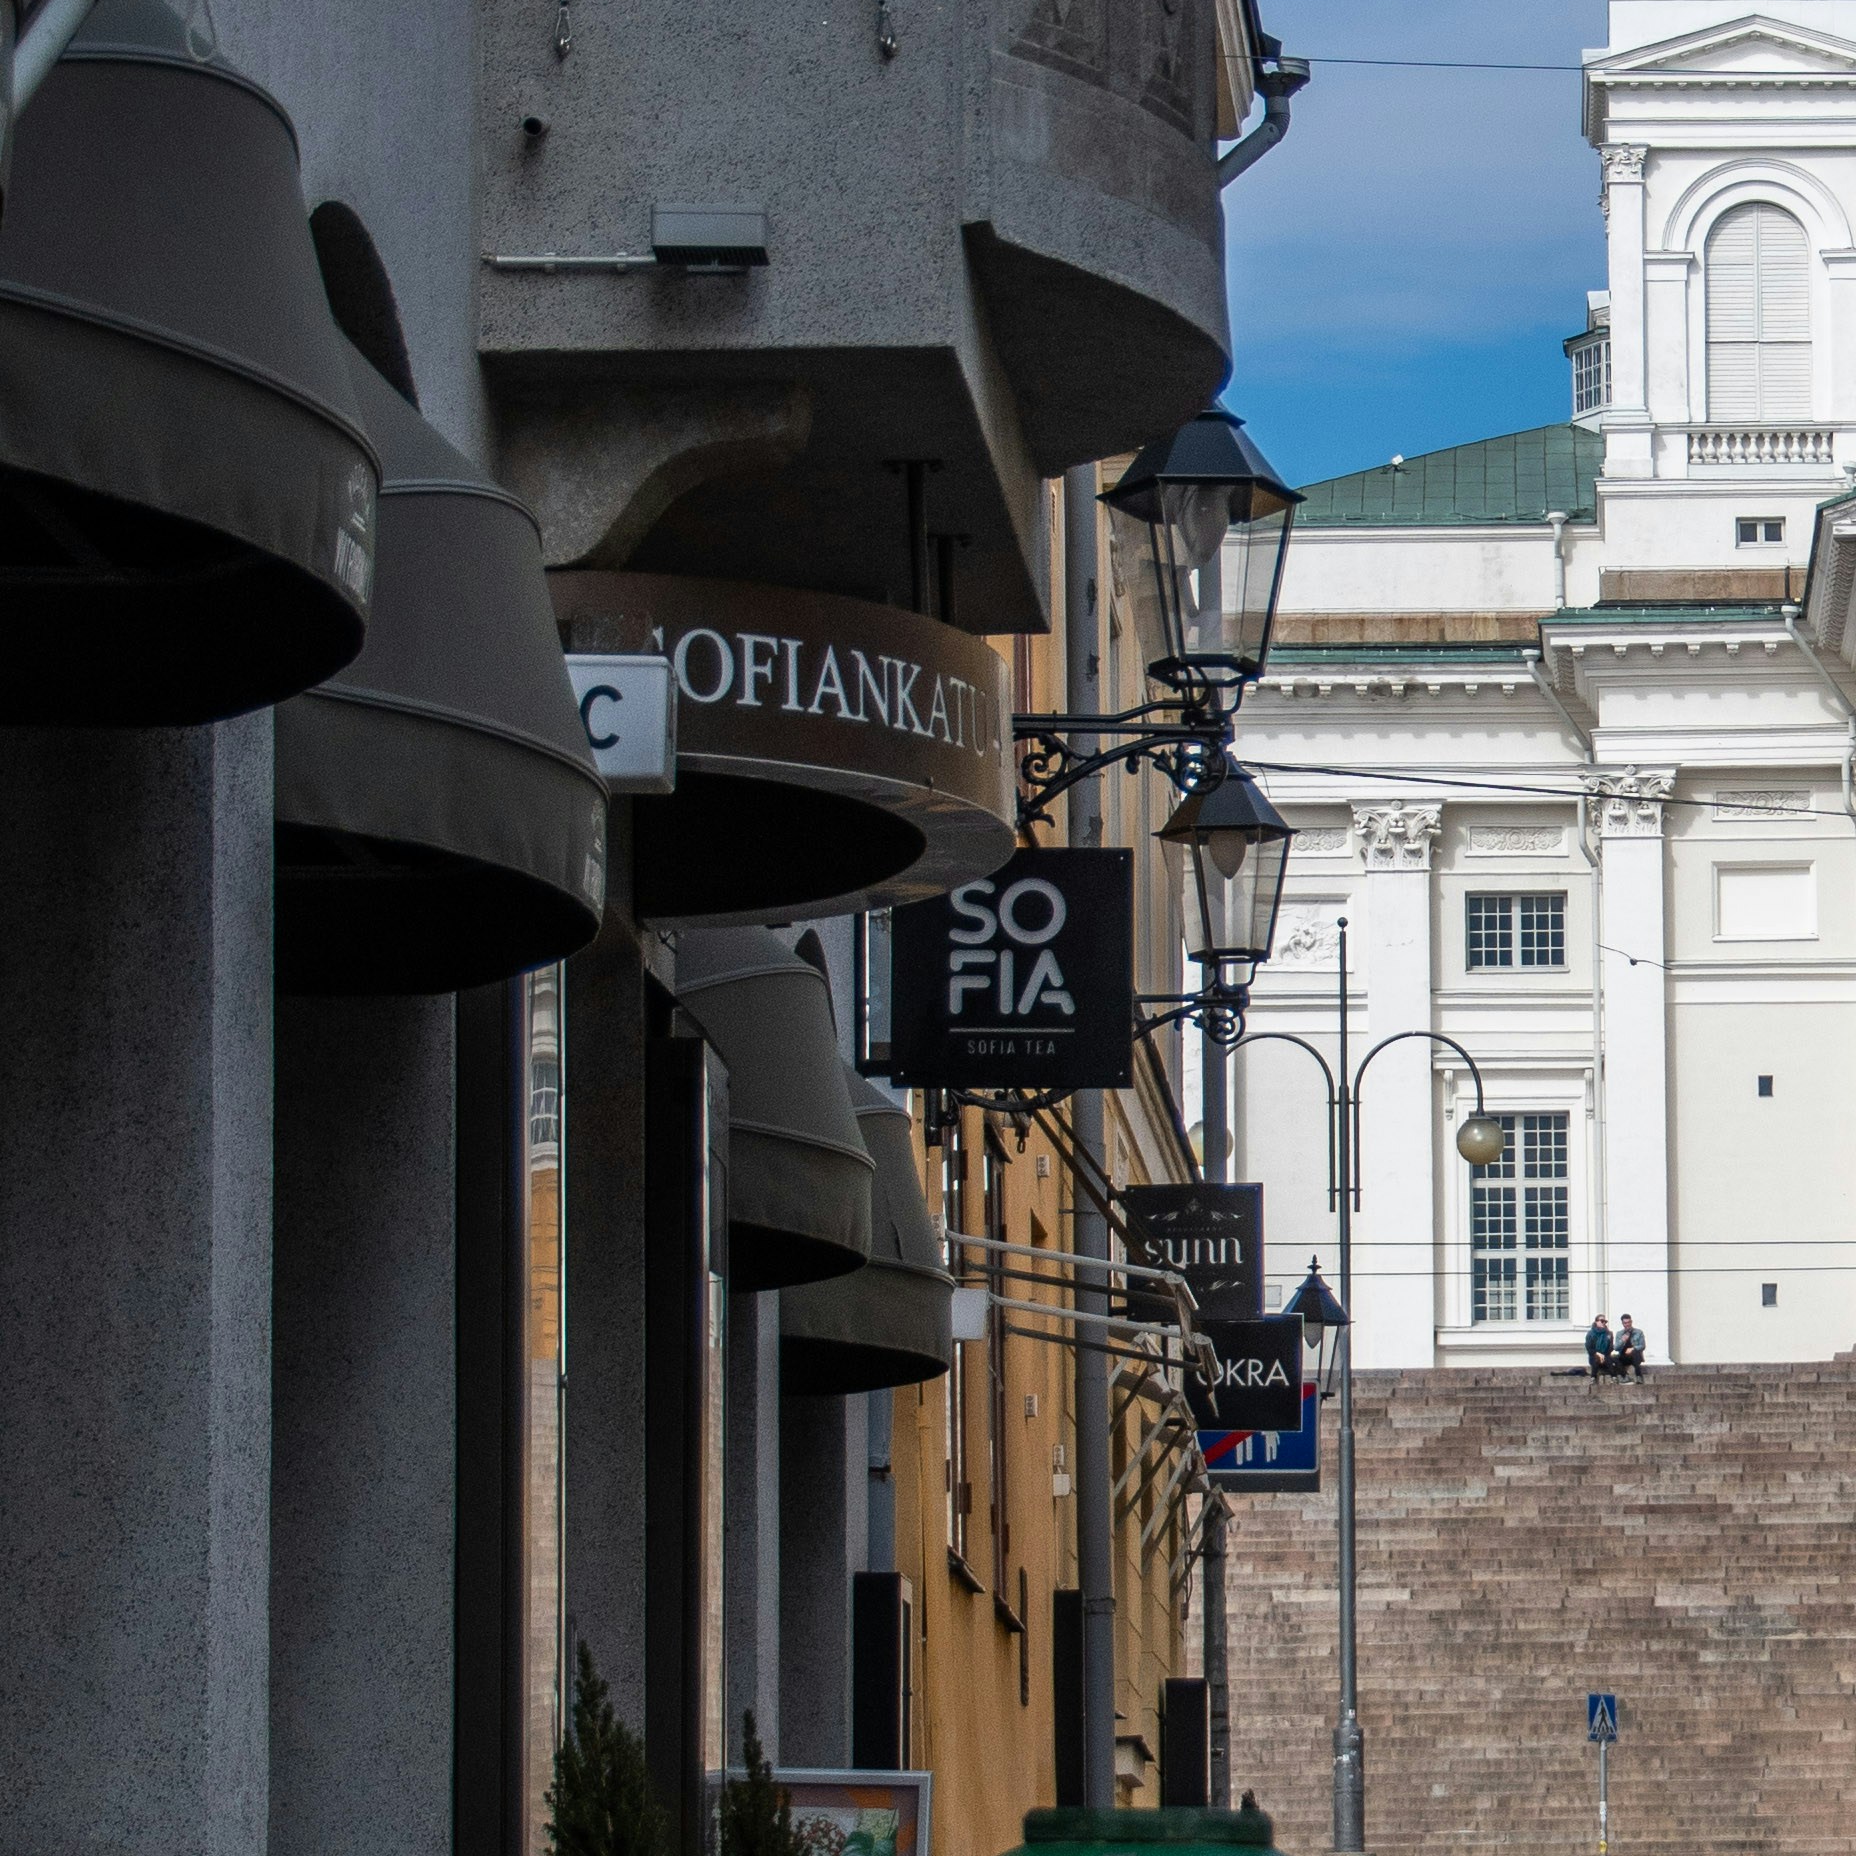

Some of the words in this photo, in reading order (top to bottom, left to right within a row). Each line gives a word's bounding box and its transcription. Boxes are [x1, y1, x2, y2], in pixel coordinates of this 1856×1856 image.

[652, 626, 985, 757] OFIANKATU
[949, 877, 1067, 945] SO
[949, 948, 1076, 1015] FIA
[967, 1039, 1016, 1055] SOFIA
[1025, 1039, 1056, 1055] TEA
